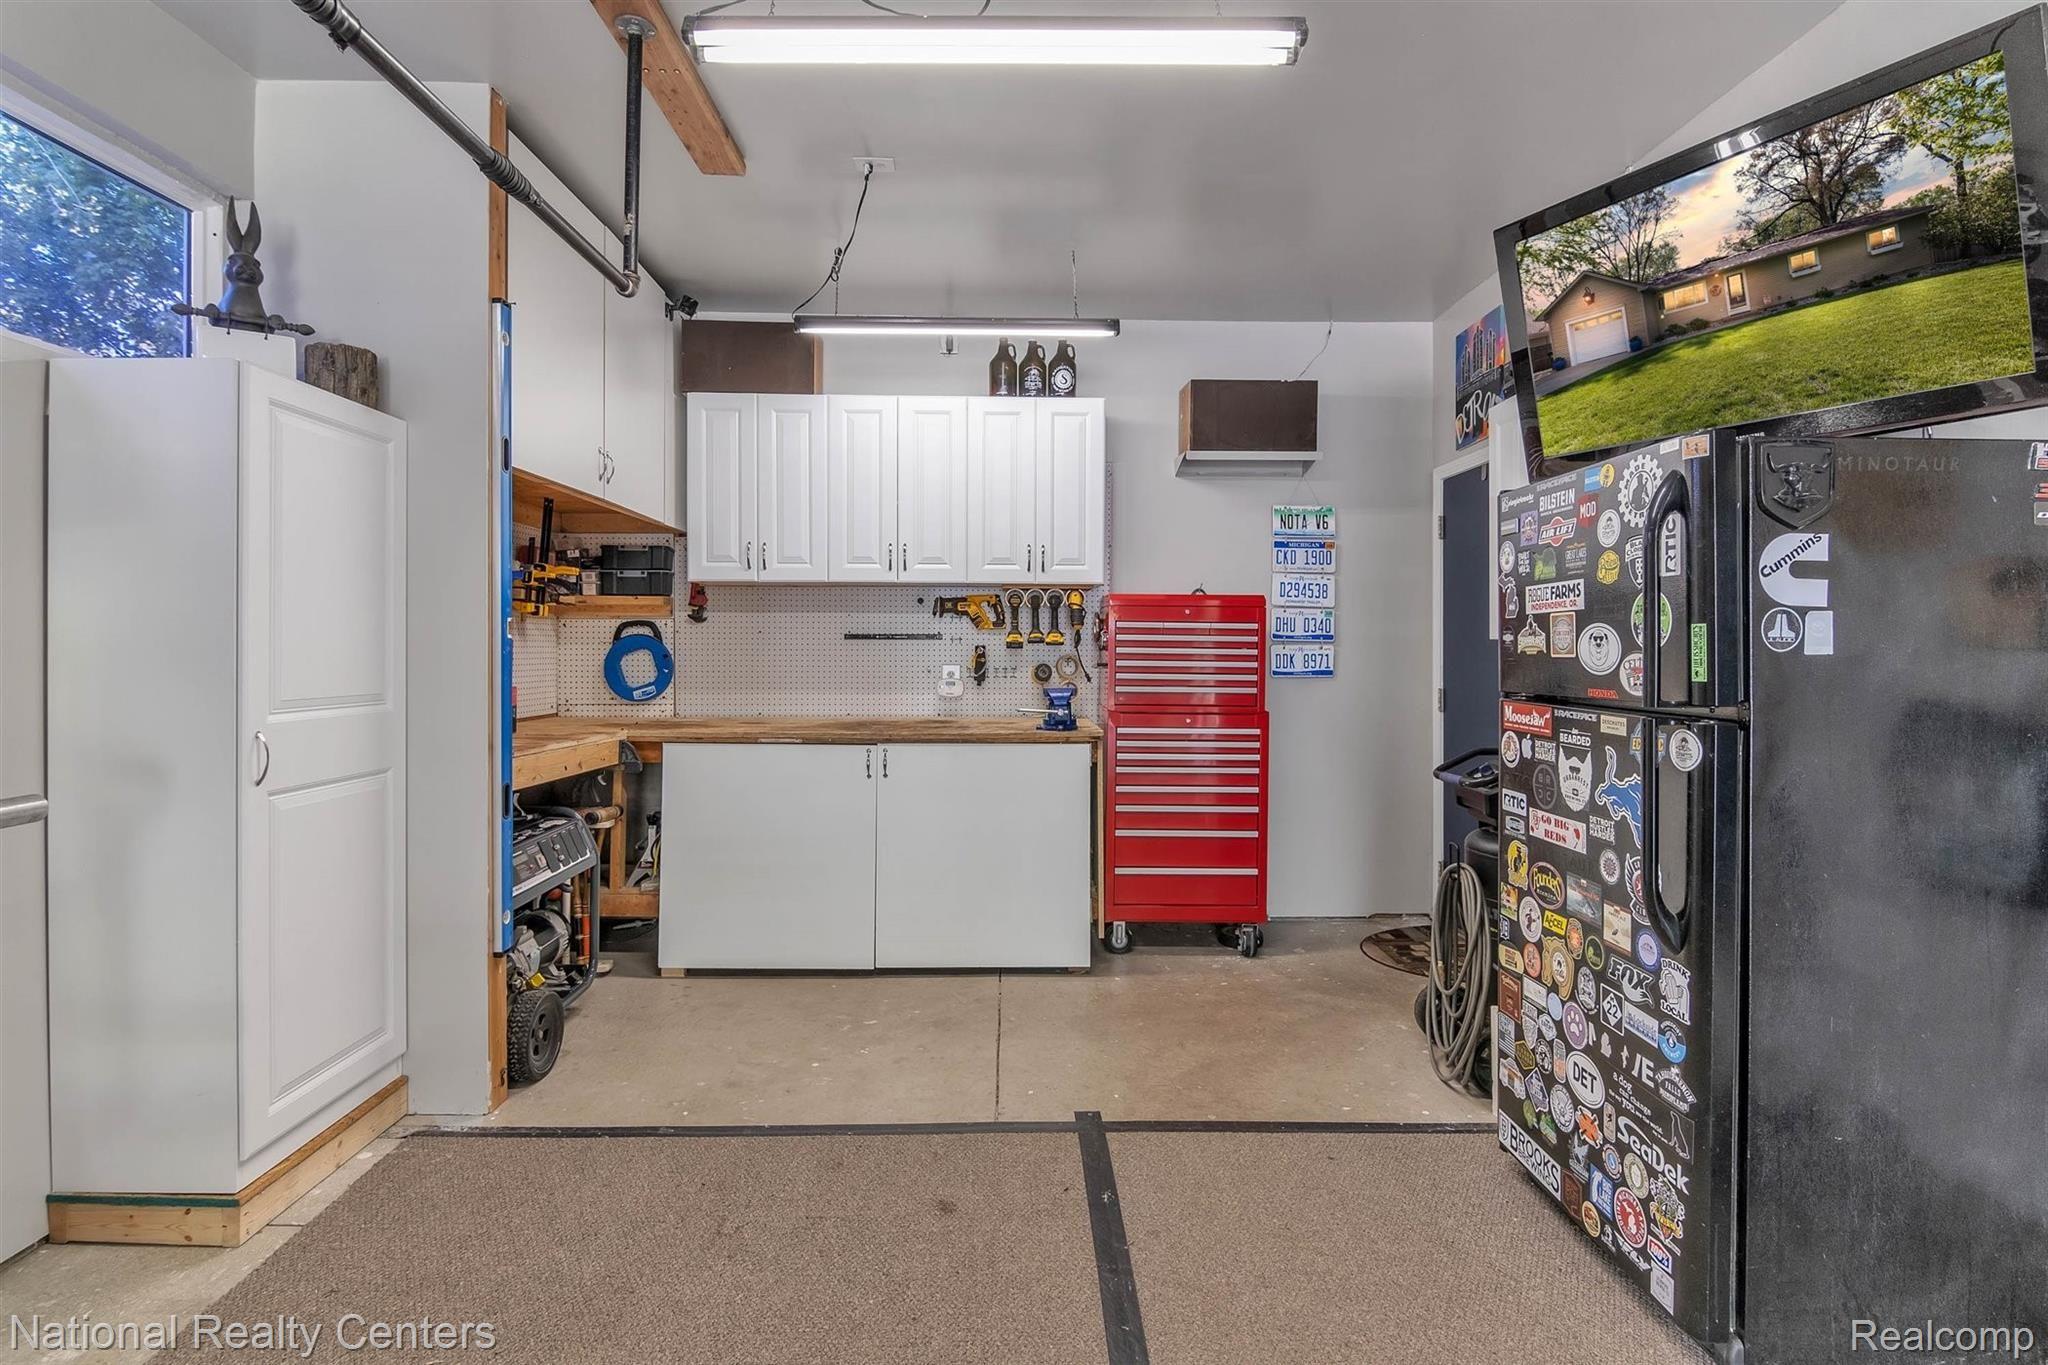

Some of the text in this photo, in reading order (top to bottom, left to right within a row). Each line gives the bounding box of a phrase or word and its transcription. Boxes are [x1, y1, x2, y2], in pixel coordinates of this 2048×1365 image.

[1838, 456, 1961, 472] MINOTAUR
[1624, 462, 1646, 488] MADE
[1539, 488, 1575, 511] BILSTEIN
[1580, 501, 1596, 518] MOD
[1280, 514, 1329, 530] NOTA V6
[1542, 523, 1573, 539] AIR LIFT
[1665, 517, 1676, 573] RTIC
[1304, 550, 1332, 565] 1900
[1760, 534, 1822, 578] Cummins
[1280, 582, 1329, 599] D294538
[1528, 582, 1581, 603] ROGUE FARMS
[1275, 617, 1332, 633] DHU 0340
[1275, 653, 1331, 669] DDK 8971
[1588, 687, 1618, 698] HONDA
[1504, 705, 1551, 727] Moosejaw
[1560, 732, 1591, 747] BEARDED
[1503, 793, 1526, 811] RTIC
[1541, 815, 1570, 831] GO BIG
[1589, 815, 1615, 827] DETROIT
[1544, 828, 1567, 844] REDS
[1609, 957, 1651, 991] FOX
[1661, 959, 1688, 980] DRINK
[1607, 1001, 1618, 1019] 22
[1661, 1001, 1688, 1023] LOCAL
[1573, 1061, 1597, 1094] DET
[1613, 1072, 1633, 1095] a dog
[1619, 1088, 1630, 1099] can
[1630, 1096, 1652, 1116] change
[1622, 1097, 1635, 1114] you
[1510, 1122, 1559, 1194] BROOKS
[1617, 1116, 1690, 1196] SeaDek
[1518, 1149, 1553, 1187] BREWING
[1650, 1241, 1669, 1267] 100%
